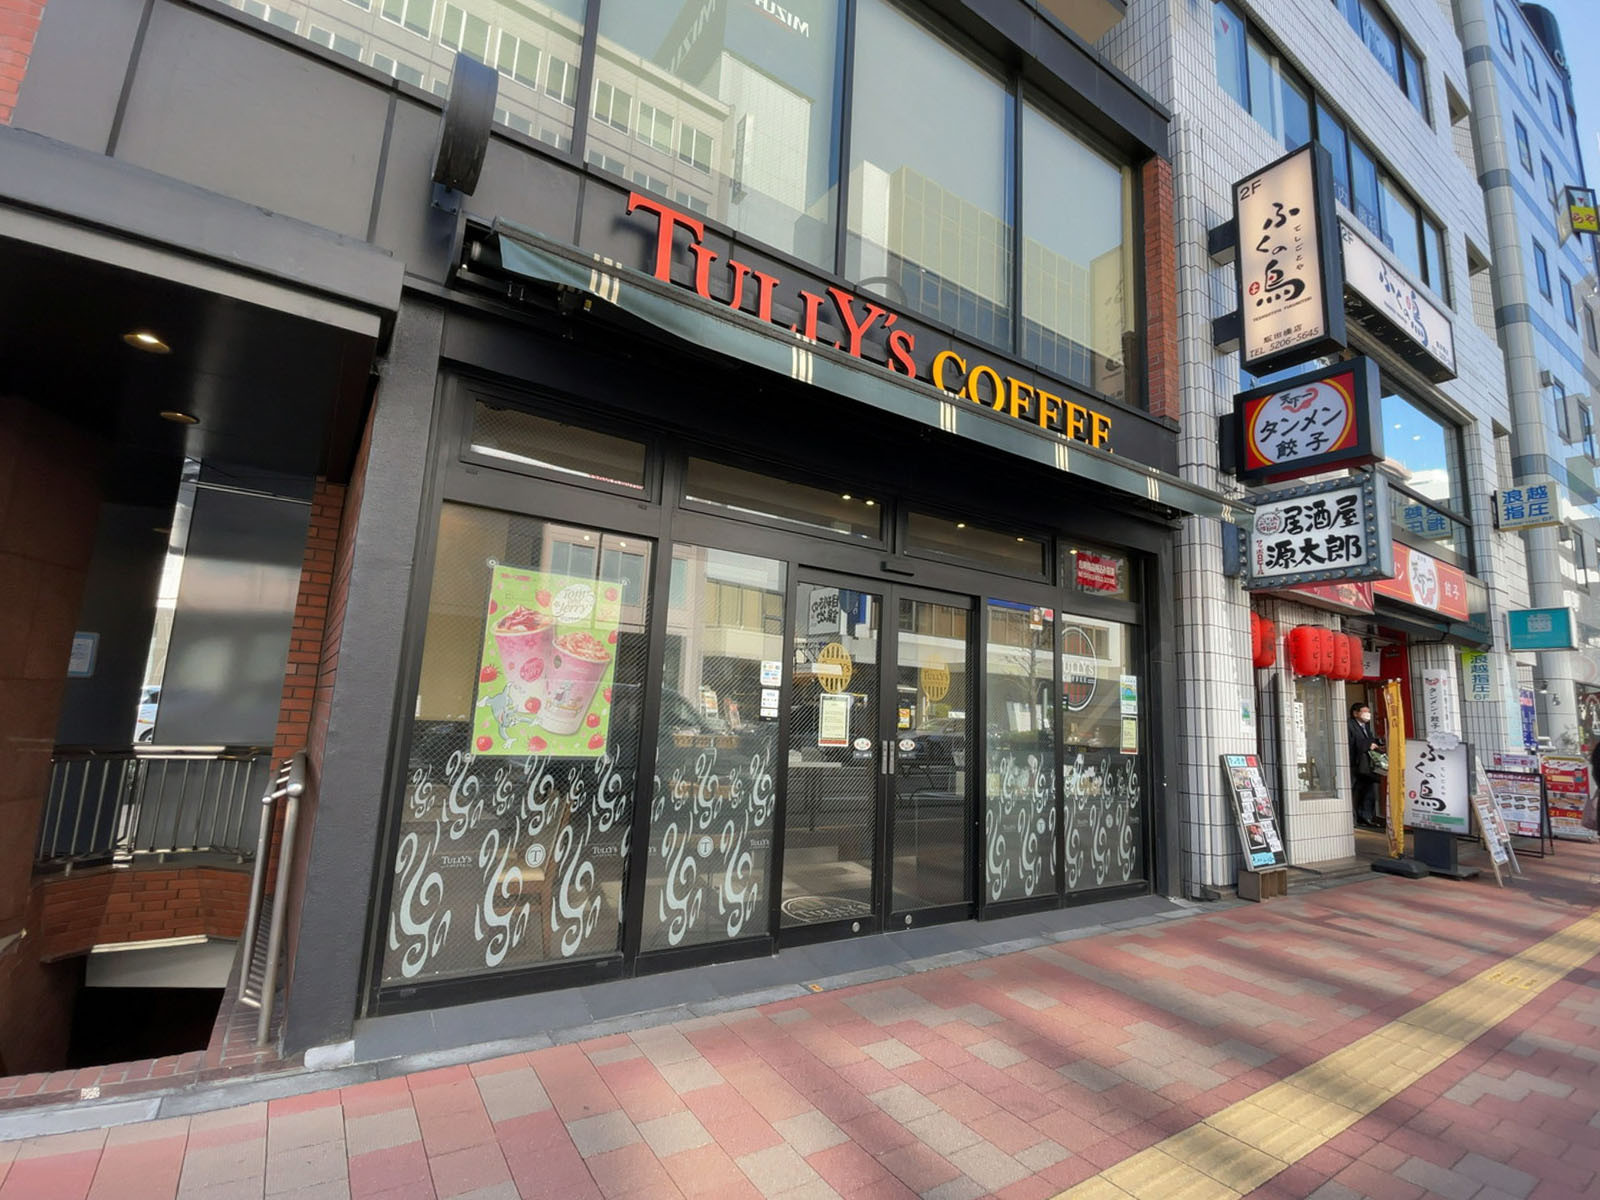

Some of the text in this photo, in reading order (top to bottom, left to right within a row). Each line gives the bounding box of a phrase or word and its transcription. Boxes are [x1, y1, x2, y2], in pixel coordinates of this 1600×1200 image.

[1239, 179, 1262, 201] 2F
[1260, 407, 1342, 443] タンメン
[1276, 432, 1329, 459] 餃子
[1502, 485, 1549, 504] 浪越
[1279, 495, 1359, 535] 居酒屋
[1503, 501, 1550, 521] 指圧
[1265, 534, 1362, 570] 源太郎
